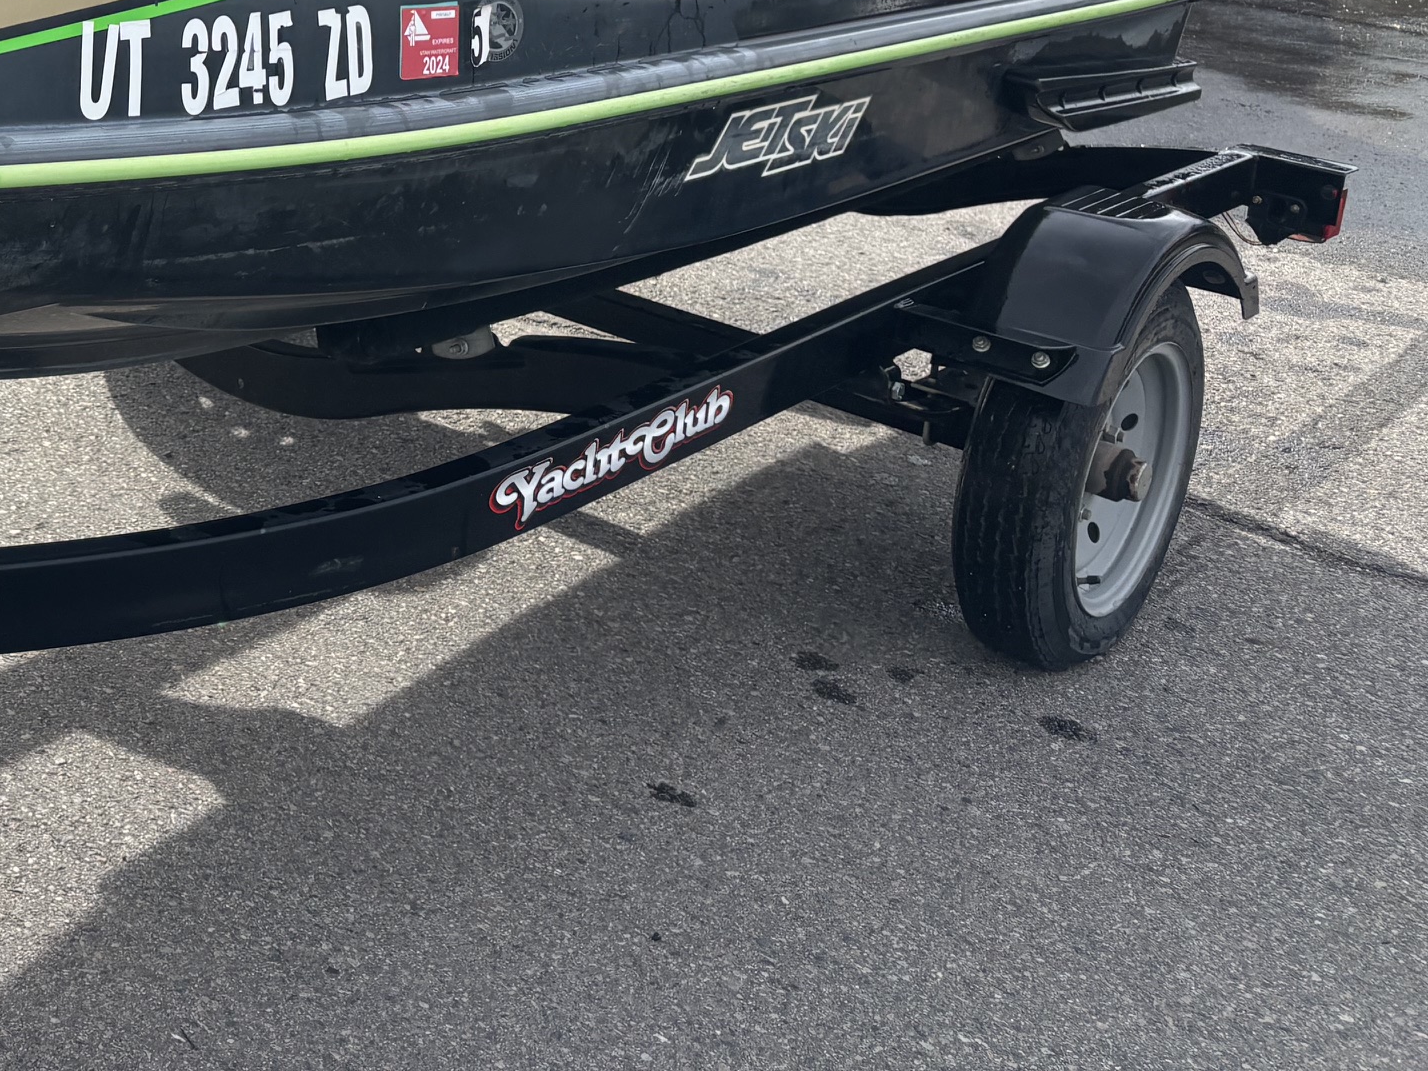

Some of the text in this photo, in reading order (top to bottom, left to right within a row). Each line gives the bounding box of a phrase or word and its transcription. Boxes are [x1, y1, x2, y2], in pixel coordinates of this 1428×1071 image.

[432, 37, 454, 45] EXPIRES
[80, 4, 373, 121] UT 3245 ZD
[423, 55, 450, 74] 2024
